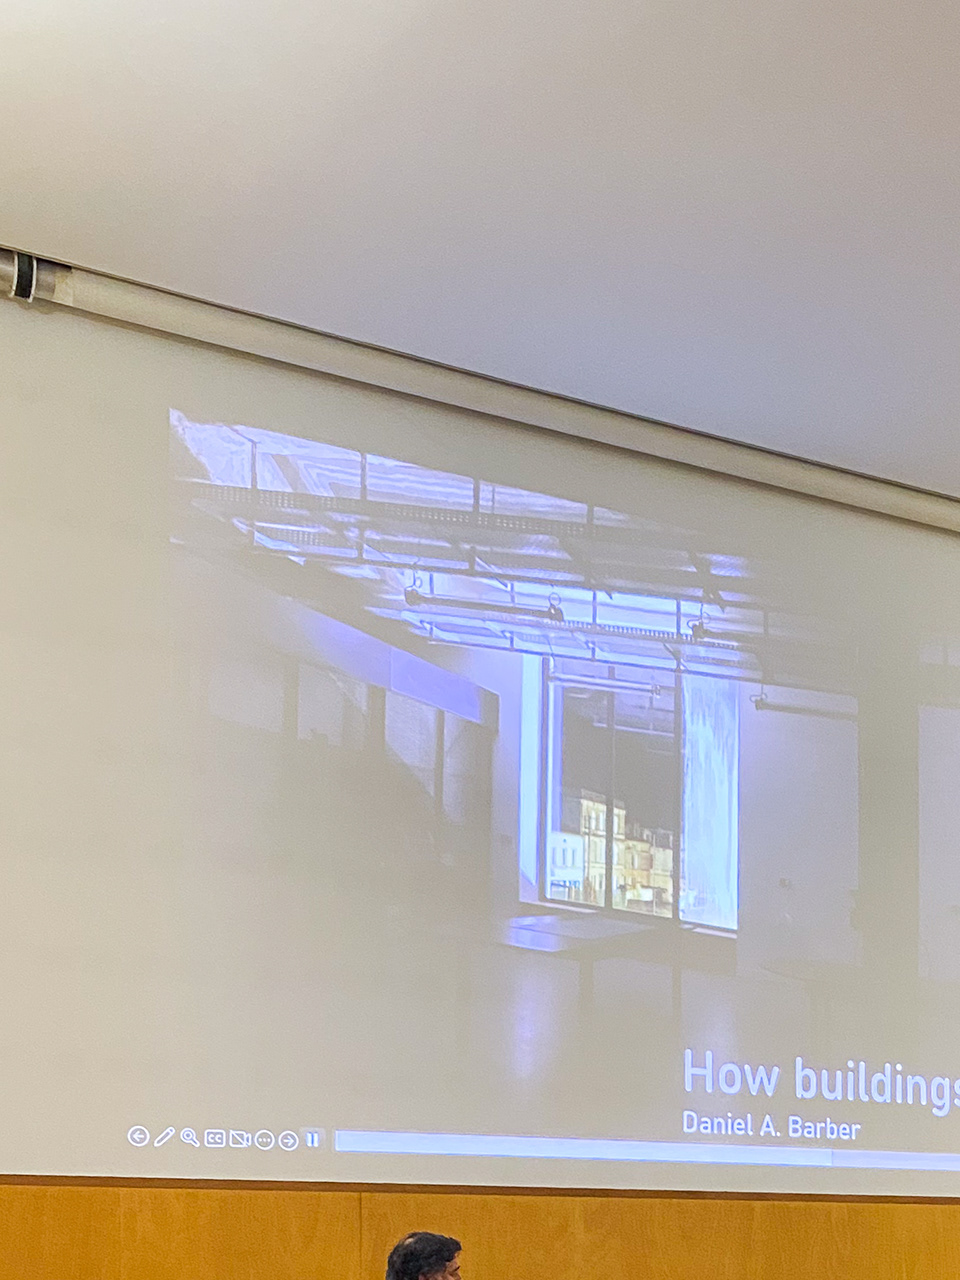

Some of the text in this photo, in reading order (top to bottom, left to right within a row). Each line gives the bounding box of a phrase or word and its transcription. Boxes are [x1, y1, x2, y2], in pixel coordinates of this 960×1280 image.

[683, 1048, 781, 1097] How
[683, 1111, 861, 1140] Daniel A. Barber
